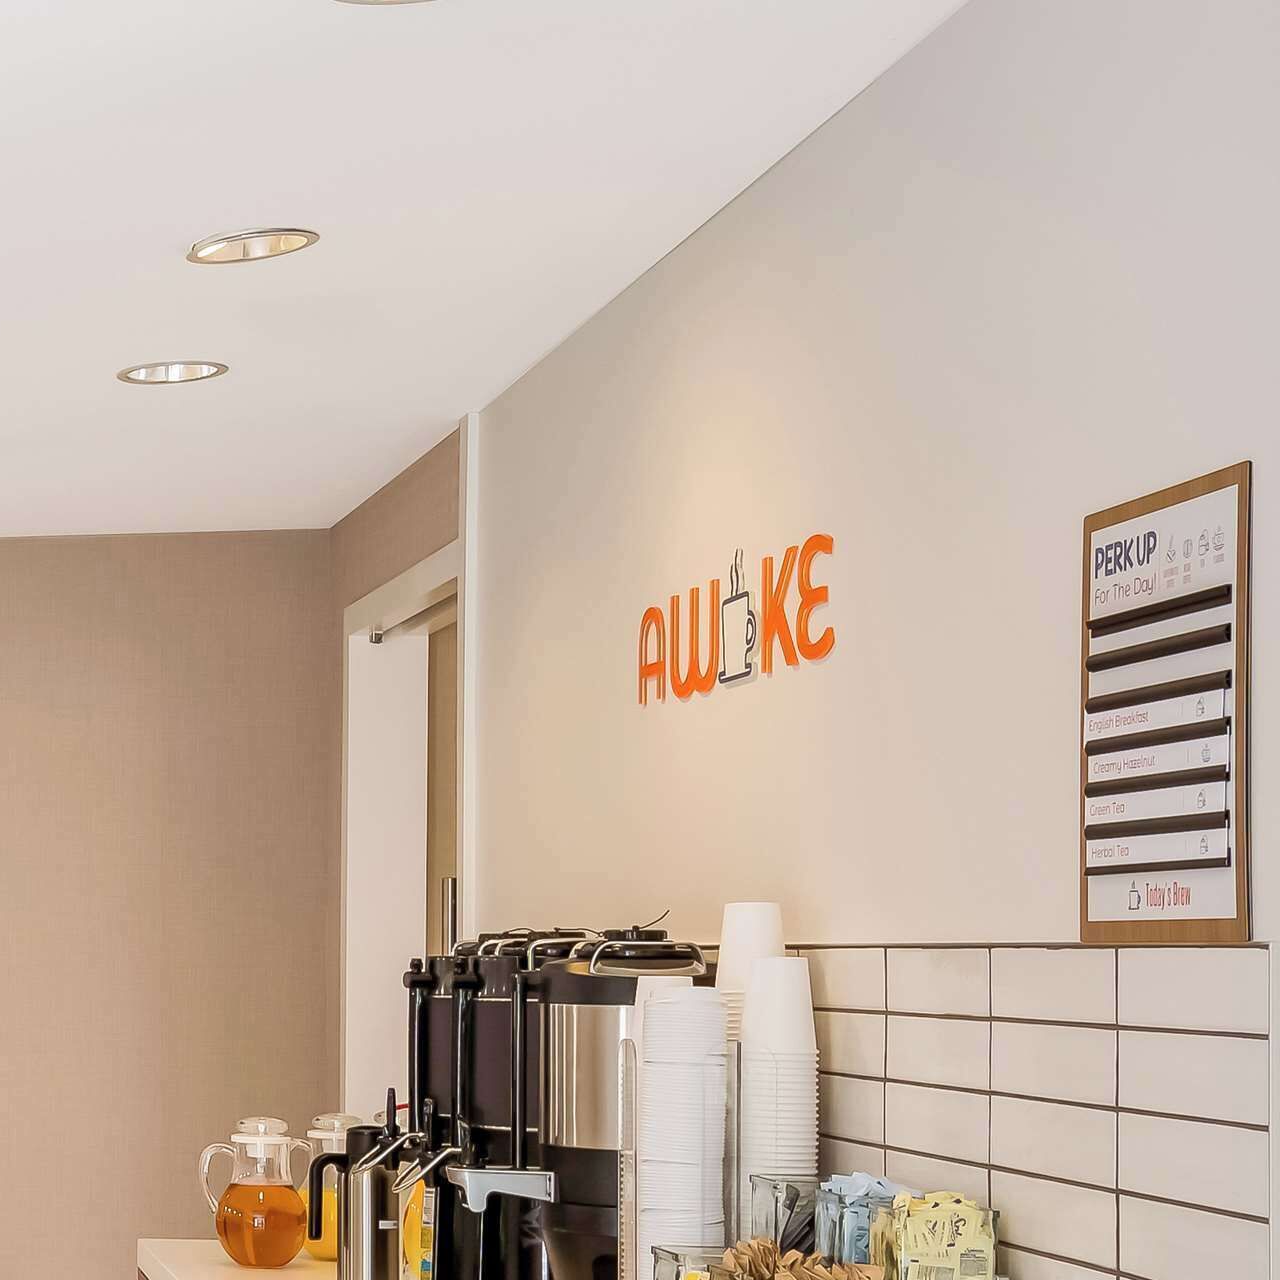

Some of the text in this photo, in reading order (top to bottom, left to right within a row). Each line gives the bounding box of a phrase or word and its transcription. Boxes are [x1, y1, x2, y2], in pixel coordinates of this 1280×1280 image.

[1095, 538, 1134, 580] PERK
[1136, 530, 1157, 567] UP
[1112, 583, 1131, 598] The
[1088, 710, 1149, 733] English Breakfast
[1093, 755, 1156, 775] Creamy Hazelnut
[1089, 801, 1125, 817] Green Tea
[1091, 844, 1129, 860] Herbal Tea
[1145, 881, 1191, 910] Today's Brew
